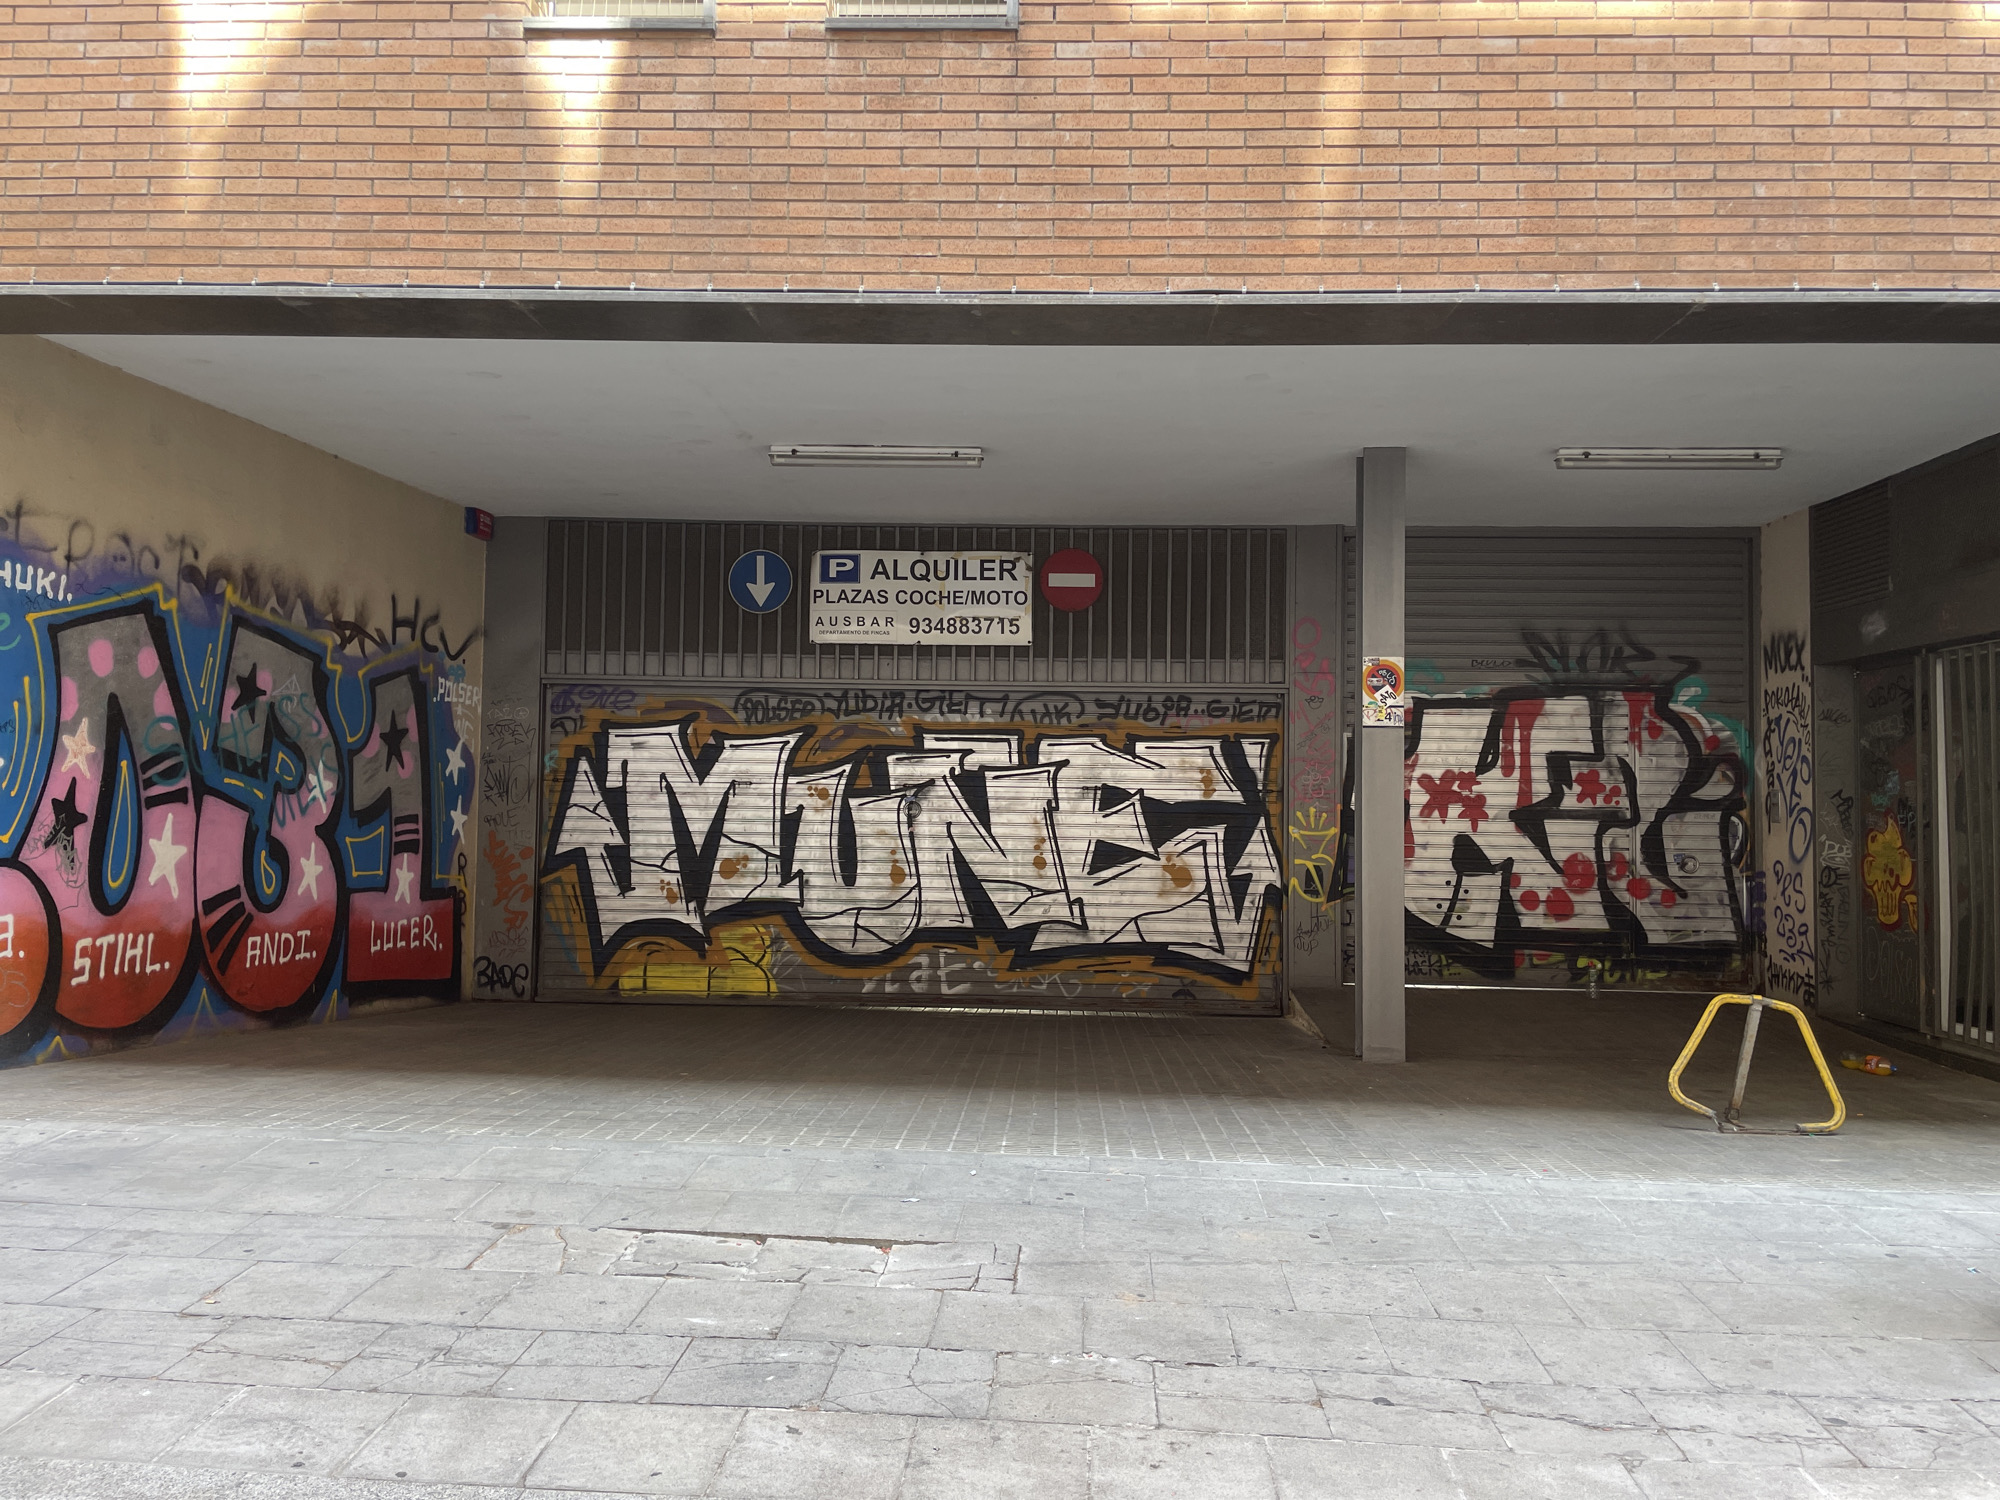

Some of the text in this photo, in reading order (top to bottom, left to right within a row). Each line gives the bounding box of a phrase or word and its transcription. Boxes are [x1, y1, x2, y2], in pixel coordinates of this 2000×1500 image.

[829, 558, 1018, 582] P ALQUILER
[813, 589, 1028, 606] PLAZAS COCHE/MOTO
[909, 617, 1021, 635] 934883715
